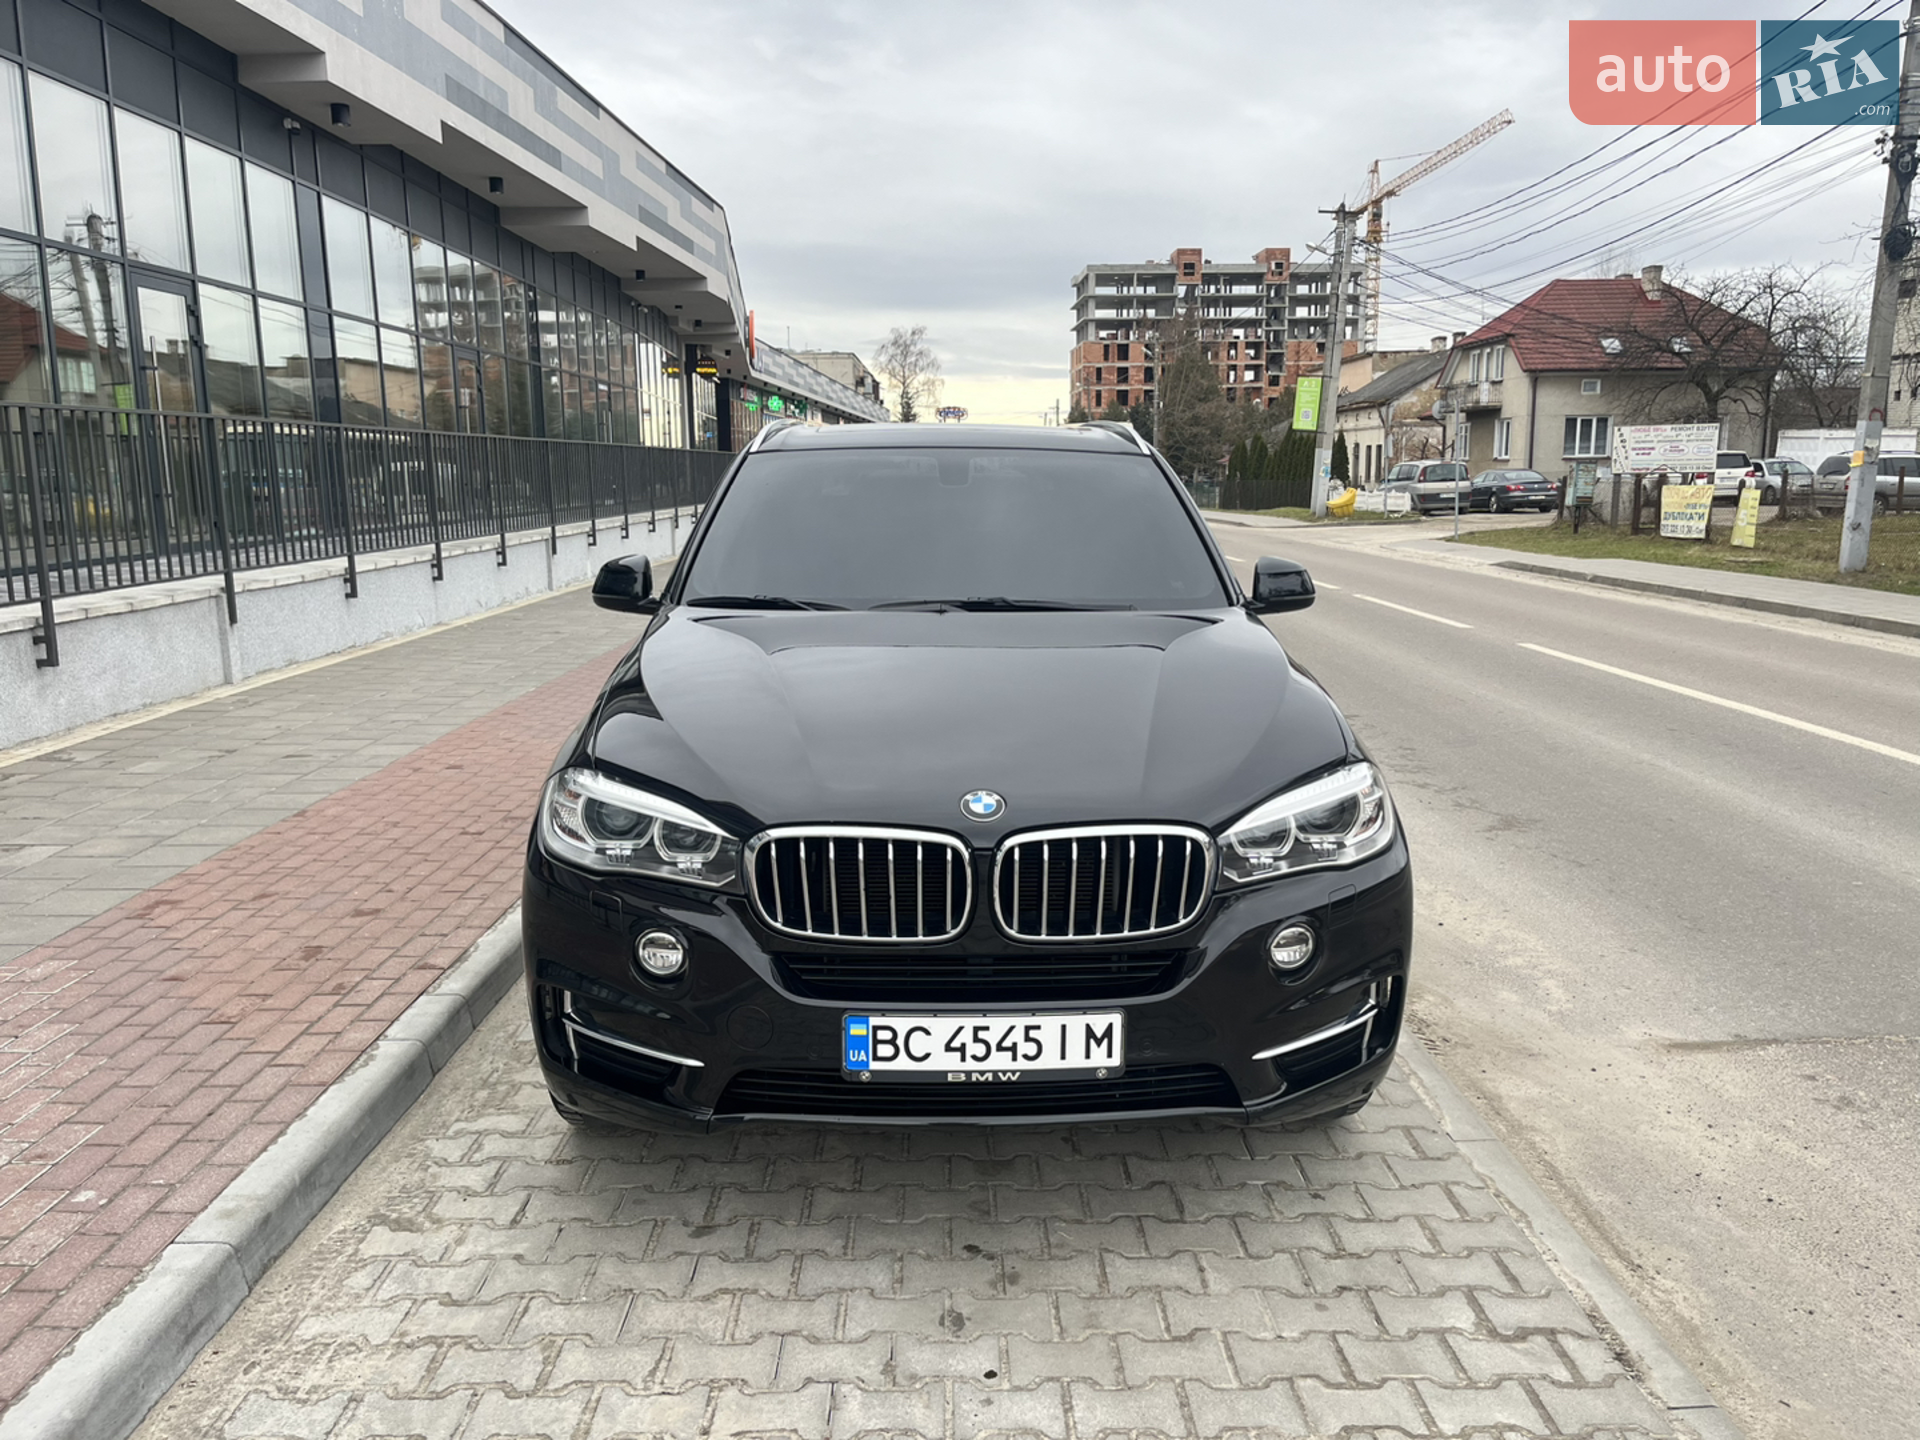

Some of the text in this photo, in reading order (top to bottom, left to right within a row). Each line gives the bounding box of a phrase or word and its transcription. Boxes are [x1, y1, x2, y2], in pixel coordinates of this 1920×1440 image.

[871, 1024, 932, 1063] BC
[944, 1024, 1043, 1063] 4545
[850, 1050, 867, 1062] UA
[947, 1071, 1021, 1082] BMW
